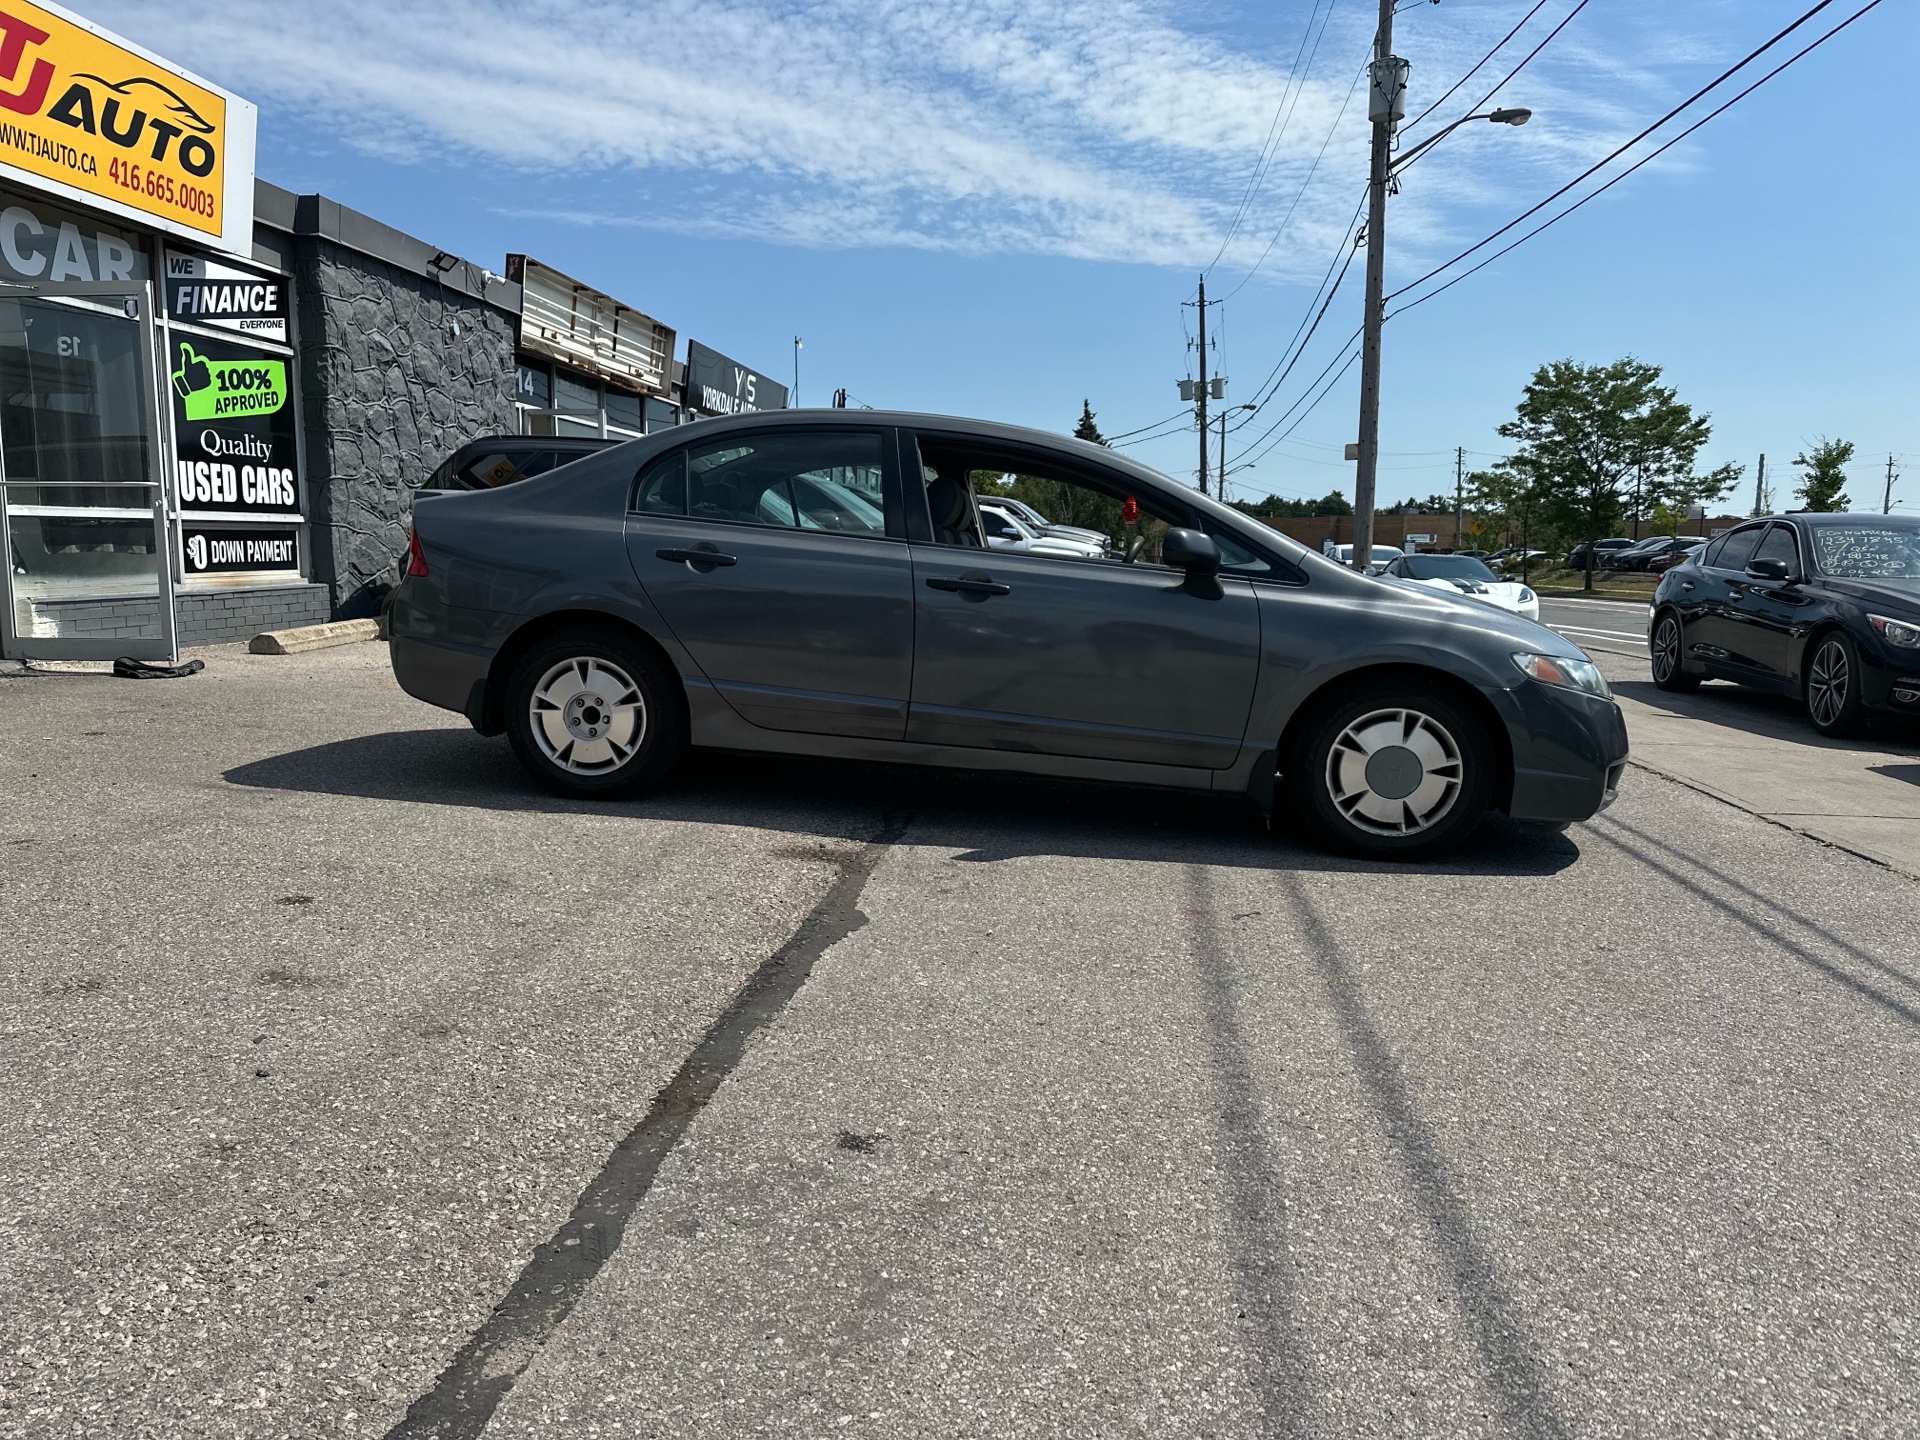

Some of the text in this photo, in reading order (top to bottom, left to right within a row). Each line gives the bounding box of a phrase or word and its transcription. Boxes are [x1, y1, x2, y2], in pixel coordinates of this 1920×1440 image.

[0, 10, 215, 178] TJ AUTO
[109, 156, 215, 219] 416.665.0003
[0, 206, 135, 282] CAR
[170, 257, 194, 276] WE
[176, 285, 278, 315] FINANCE
[239, 319, 284, 330] EVERYONE
[215, 368, 272, 392] 100%
[515, 367, 534, 396] 14
[214, 391, 280, 415] APPROVED
[702, 384, 740, 415] YORKDALE
[200, 429, 273, 463] Quality
[178, 460, 295, 506] USED CARS
[186, 534, 293, 570] $0 DOWN PAYMENT
